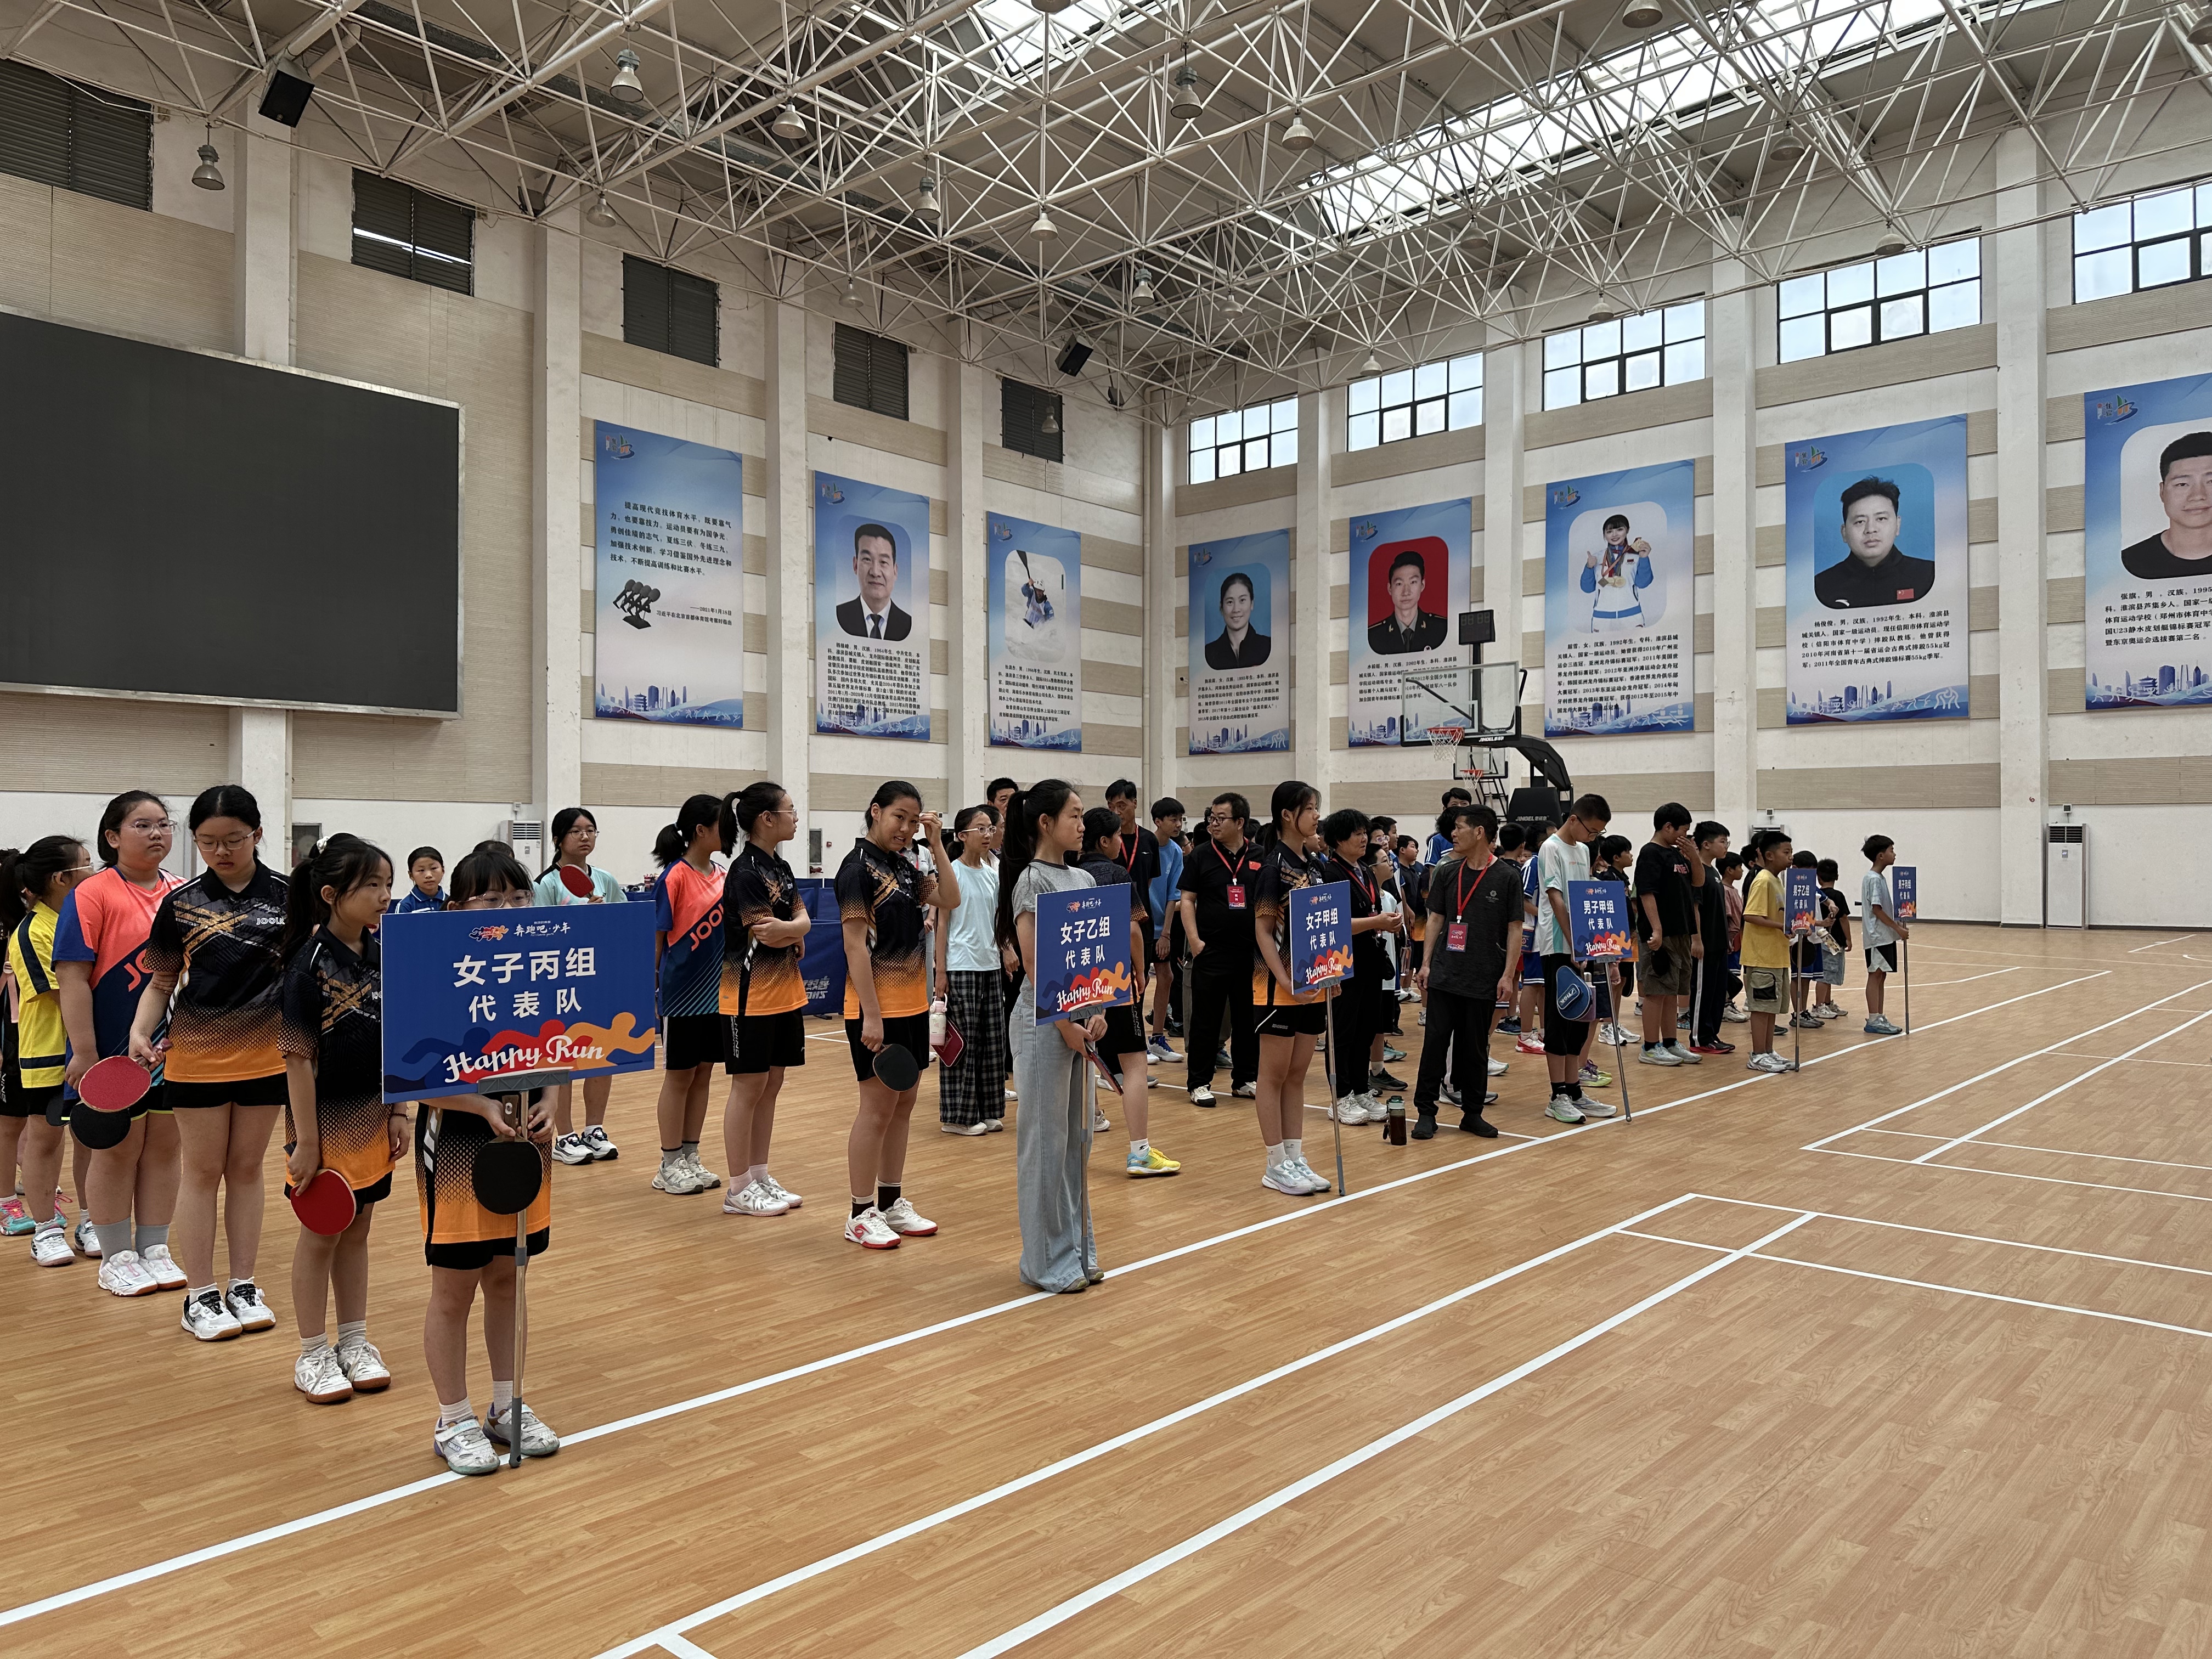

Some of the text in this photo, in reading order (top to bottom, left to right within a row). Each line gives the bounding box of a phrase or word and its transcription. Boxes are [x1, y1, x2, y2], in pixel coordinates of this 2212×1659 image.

[1306, 907, 1338, 931] 女子甲组
[1583, 900, 1615, 914] 男子甲组
[1060, 916, 1110, 945] 女子乙组
[1588, 918, 1613, 930] 代表队
[1310, 930, 1336, 951] 代表队
[1585, 938, 1621, 955] Happy Run
[453, 947, 596, 988] 女子丙组
[1065, 944, 1105, 969] 代表队
[1306, 957, 1342, 984] Happy Run
[469, 987, 582, 1023] 代表队
[1056, 978, 1113, 1012] Happy Run
[443, 1035, 605, 1084] Happy Run
